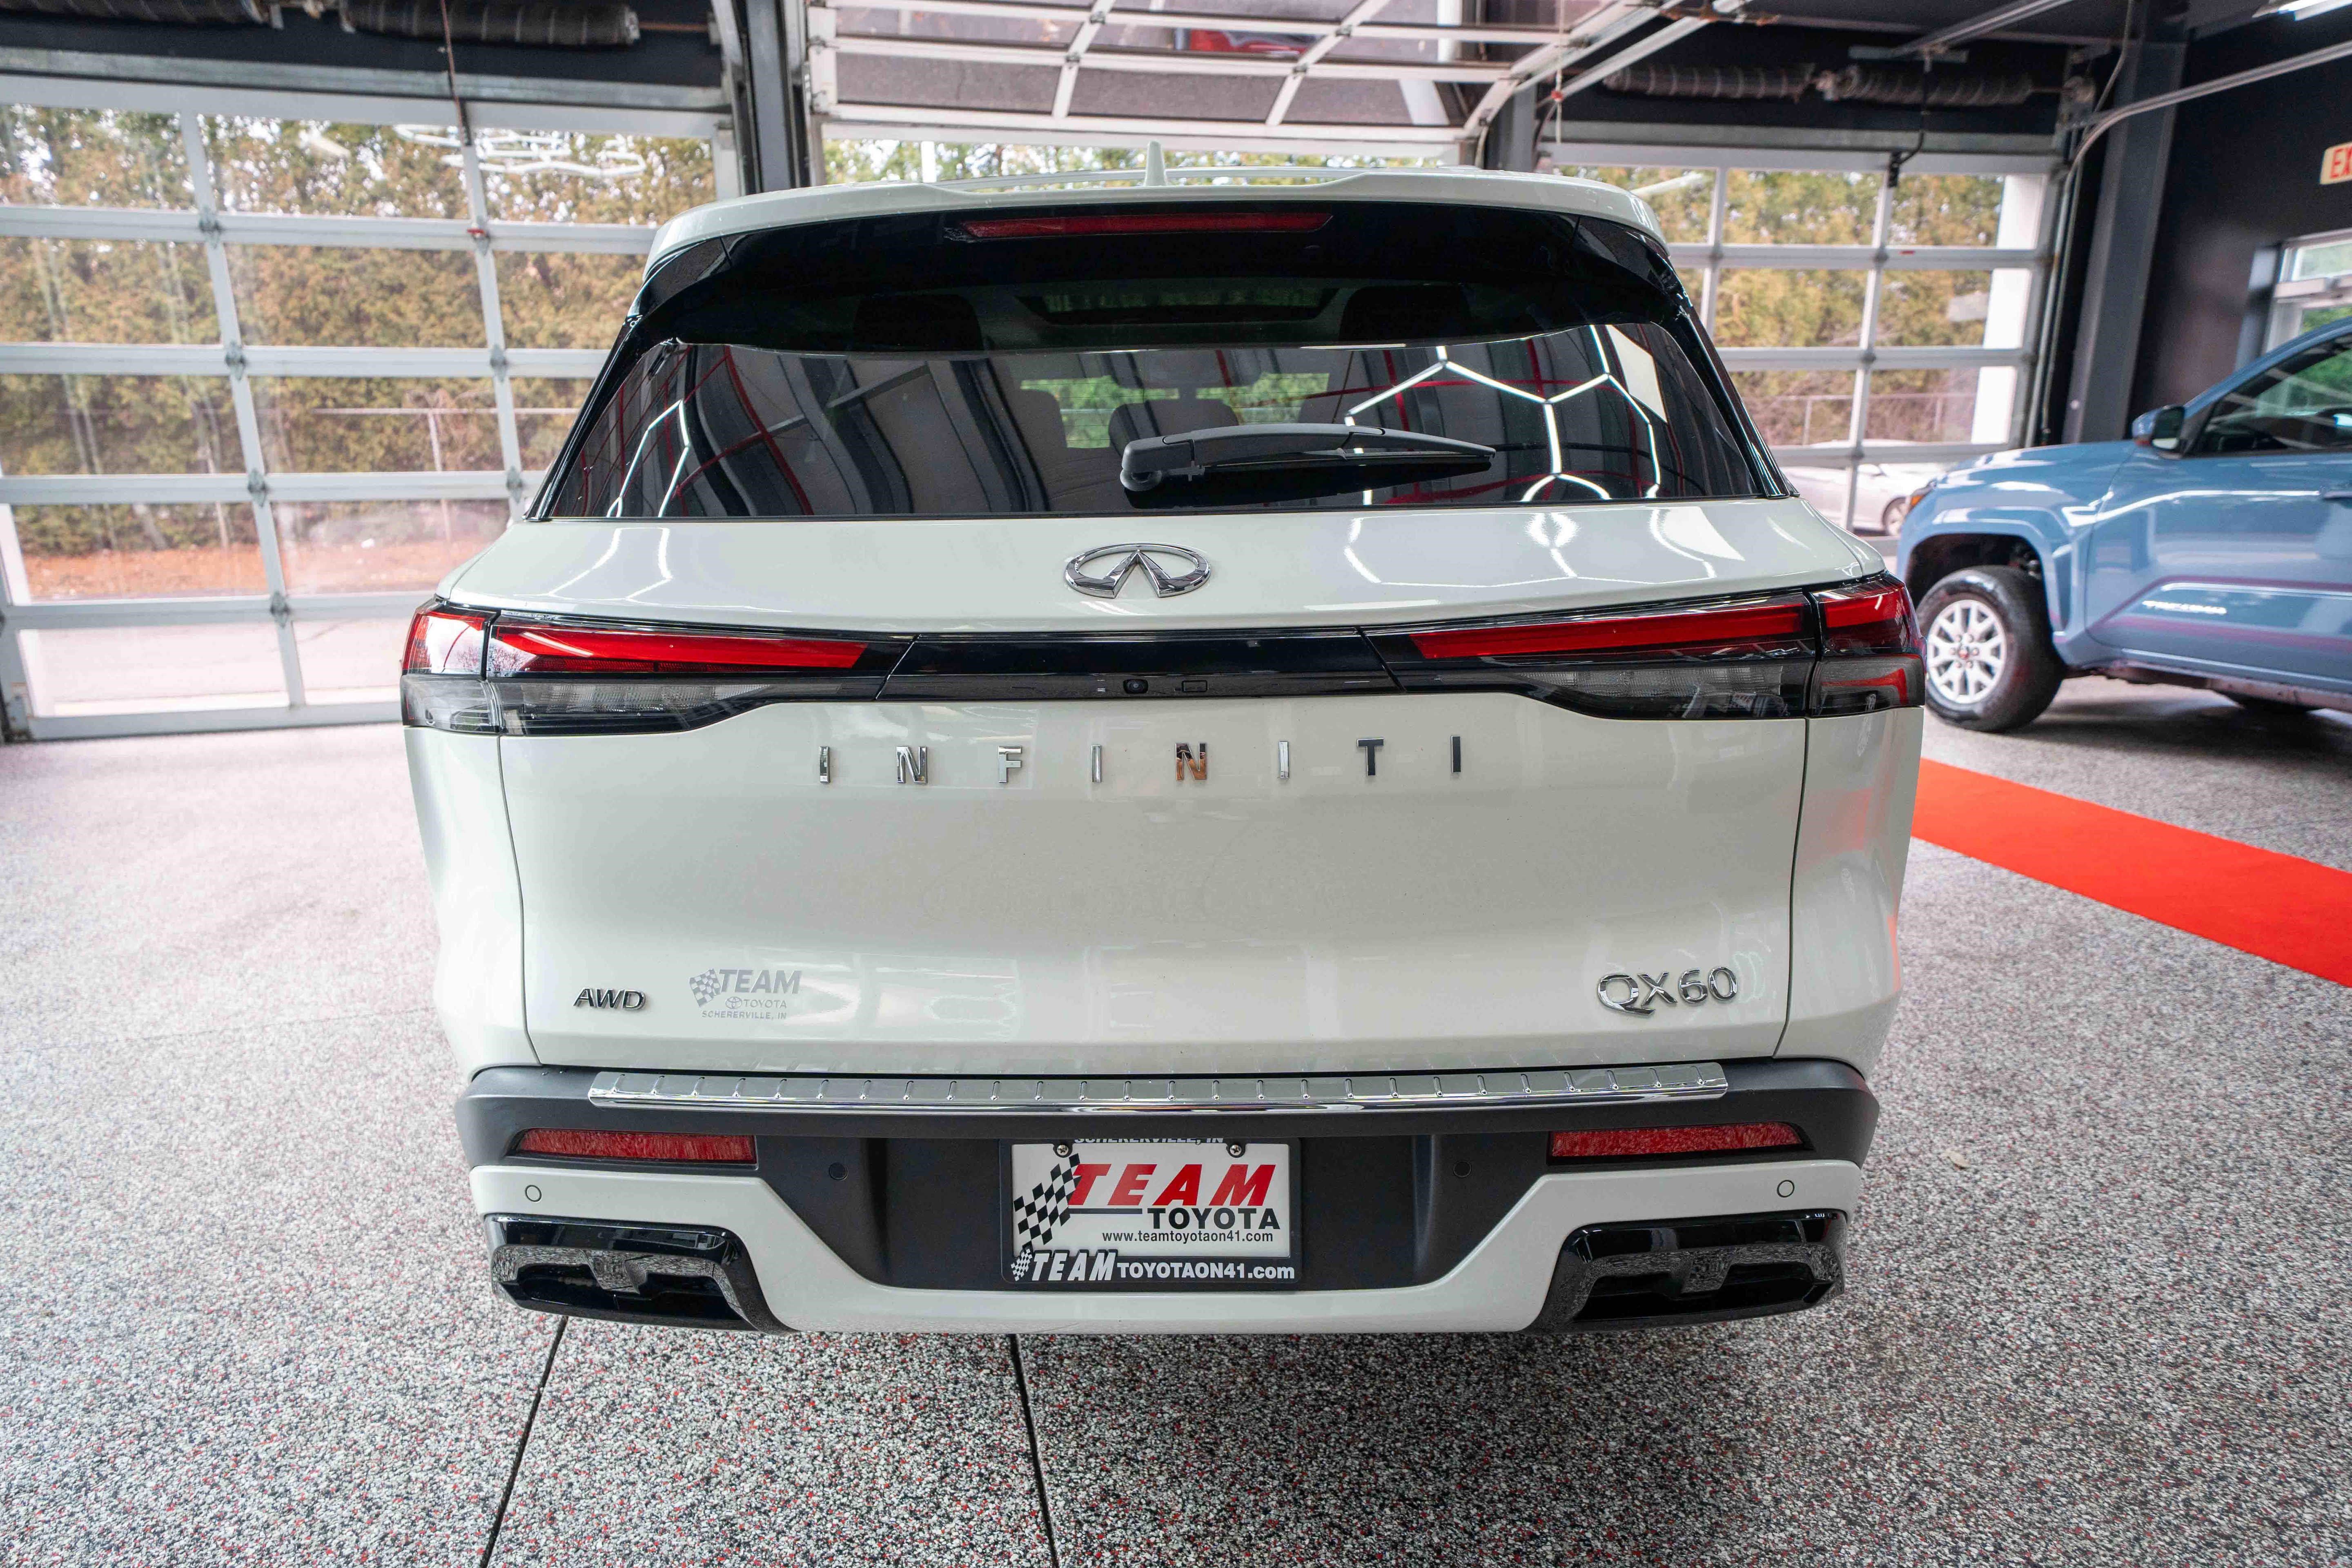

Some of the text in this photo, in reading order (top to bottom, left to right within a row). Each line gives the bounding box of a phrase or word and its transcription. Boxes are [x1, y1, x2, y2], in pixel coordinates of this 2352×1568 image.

[819, 735, 1461, 783] INFINITI
[719, 969, 802, 994] TEAM
[1598, 967, 1738, 1015] QX60
[573, 987, 646, 1009] AWD
[743, 999, 787, 1008] TOYOTA
[702, 1010, 774, 1020] SCHERERVILLE,
[1067, 1164, 1276, 1206] TEAM
[1147, 1207, 1281, 1229] TOYOTA
[1102, 1230, 1273, 1244] www.teamtoyotaon41.com
